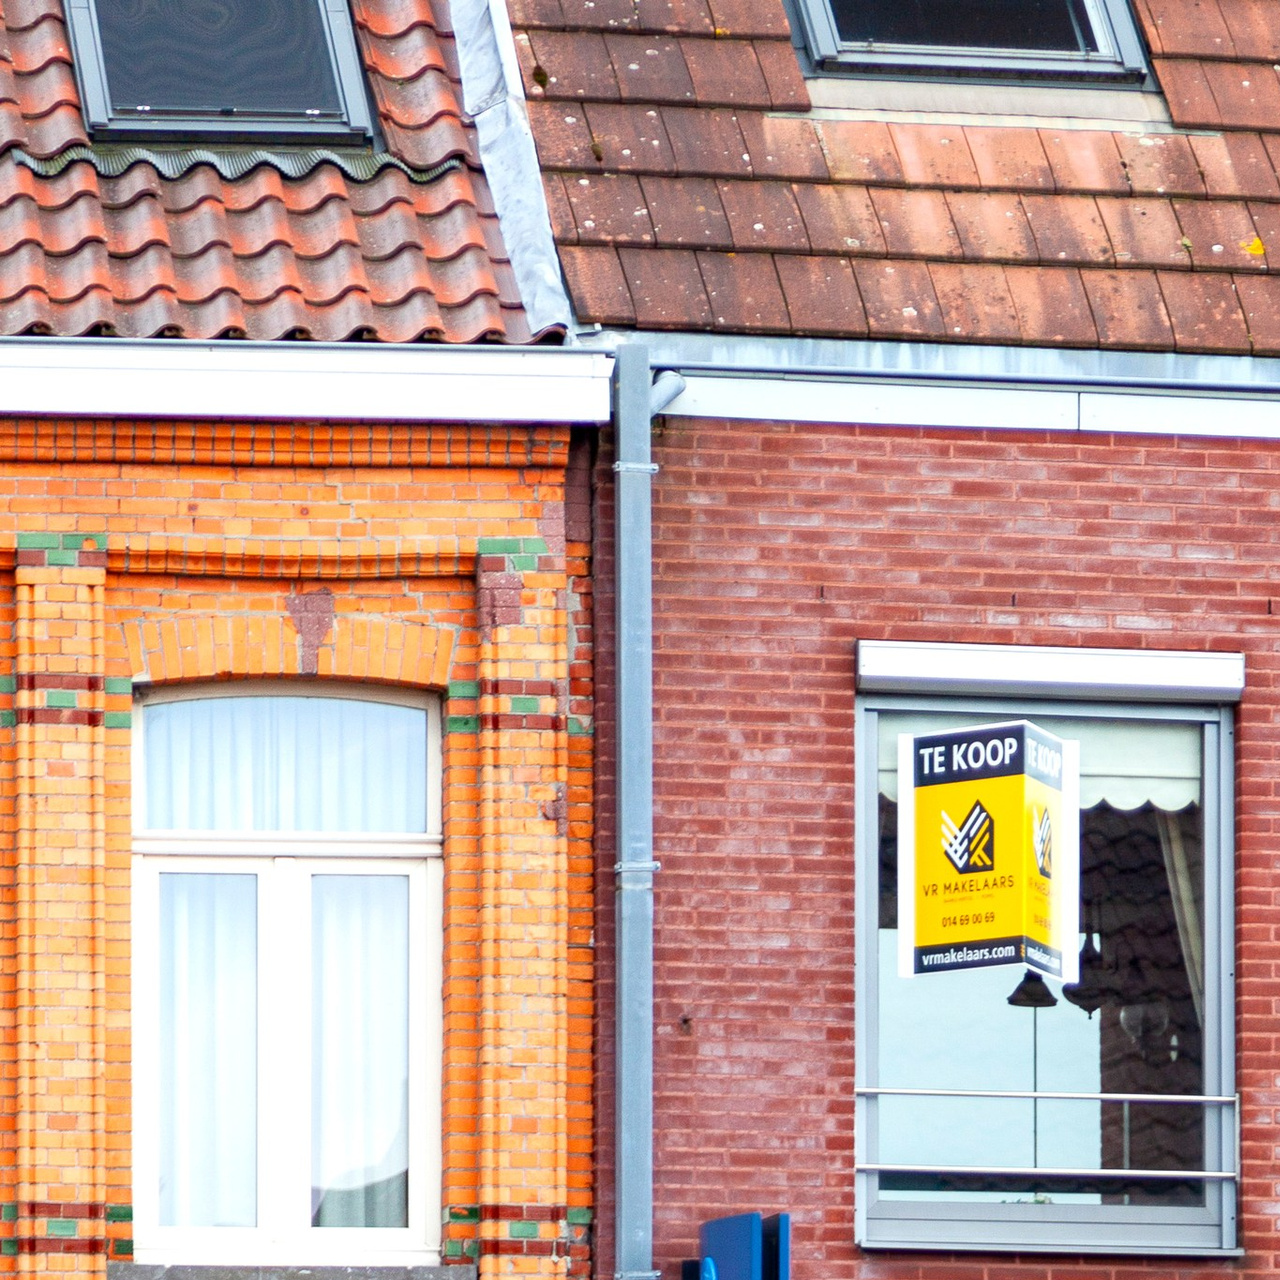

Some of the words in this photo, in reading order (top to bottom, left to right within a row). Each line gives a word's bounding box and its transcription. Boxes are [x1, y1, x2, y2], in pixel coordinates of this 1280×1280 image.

[919, 746, 946, 774] TE
[952, 738, 1018, 771] KOOP
[1026, 738, 1037, 767] TE
[1038, 743, 1062, 778] KOOP
[923, 883, 939, 897] VR
[943, 875, 1015, 895] MAKELAARS
[942, 916, 957, 928] 014
[960, 914, 970, 926] 69
[972, 913, 983, 925] 00
[985, 911, 995, 923] 69
[922, 945, 1015, 966] vrmakelaars.com
